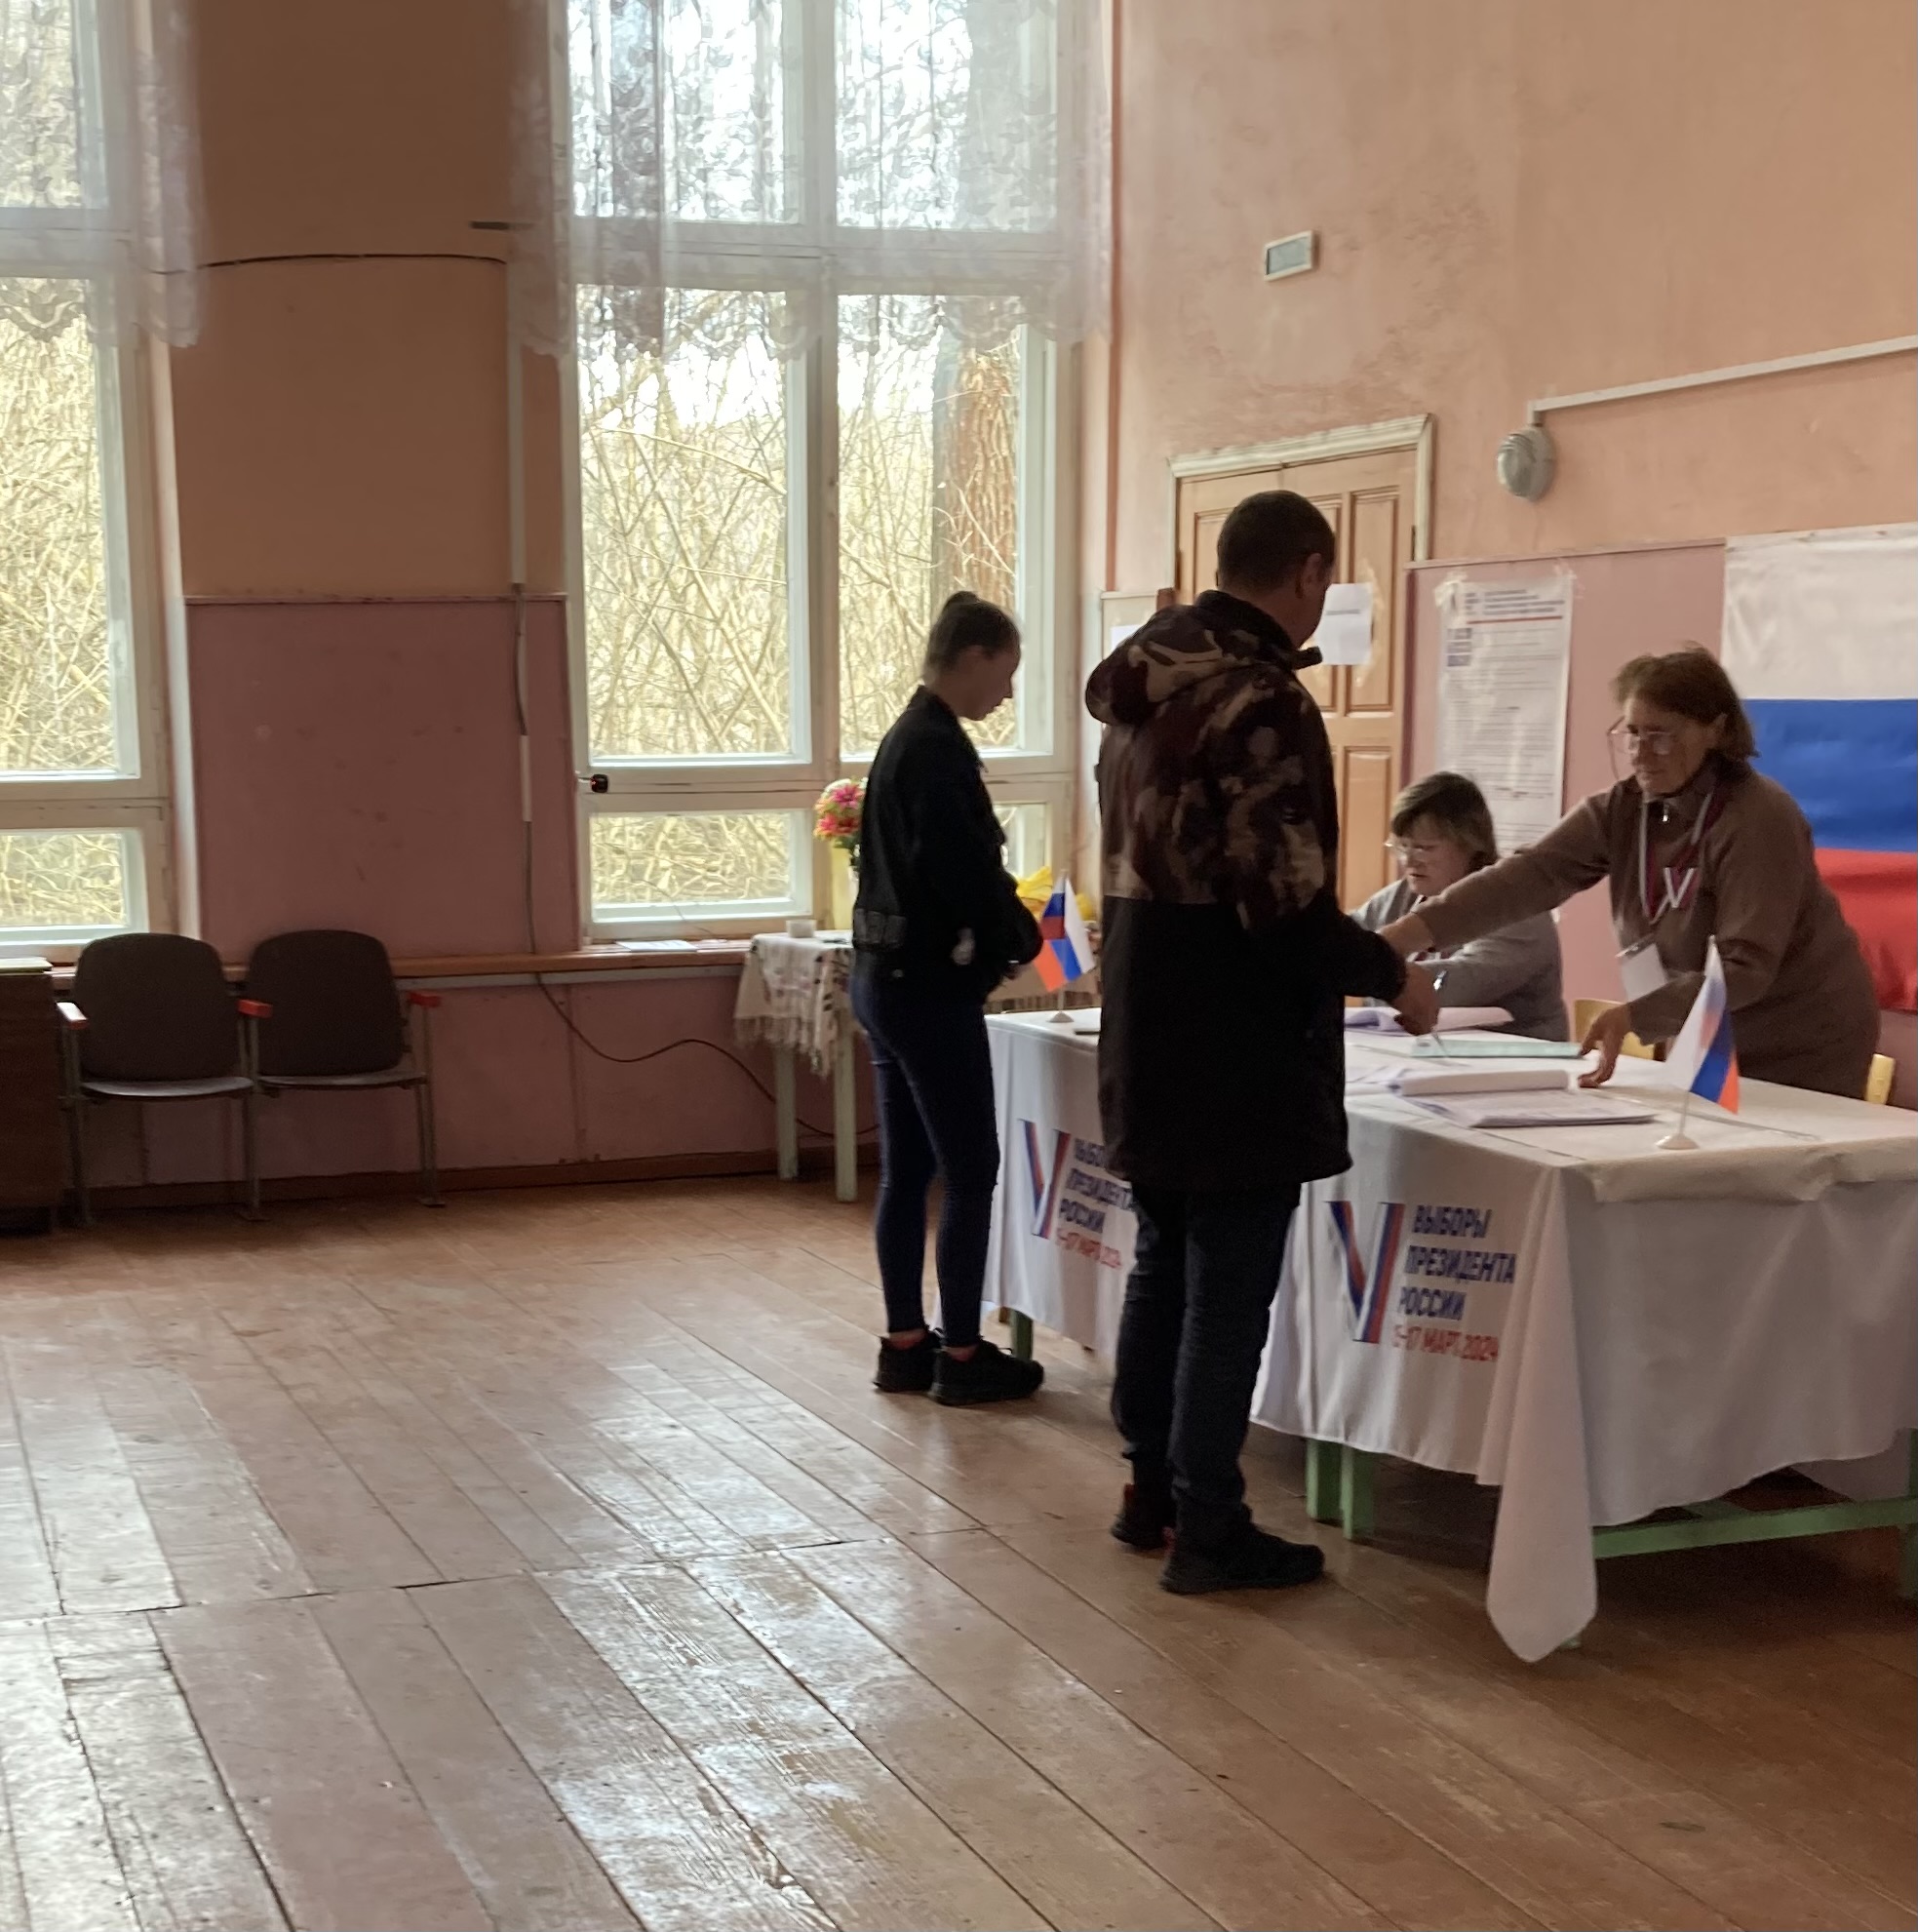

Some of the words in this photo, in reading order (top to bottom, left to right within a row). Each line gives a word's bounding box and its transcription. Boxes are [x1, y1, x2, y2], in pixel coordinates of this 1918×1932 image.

[1412, 1204, 1492, 1239] ВЫБОРЫ
[1404, 1244, 1516, 1284] ПРЕЗИДЕНТА
[1397, 1286, 1467, 1321] РОССИИ
